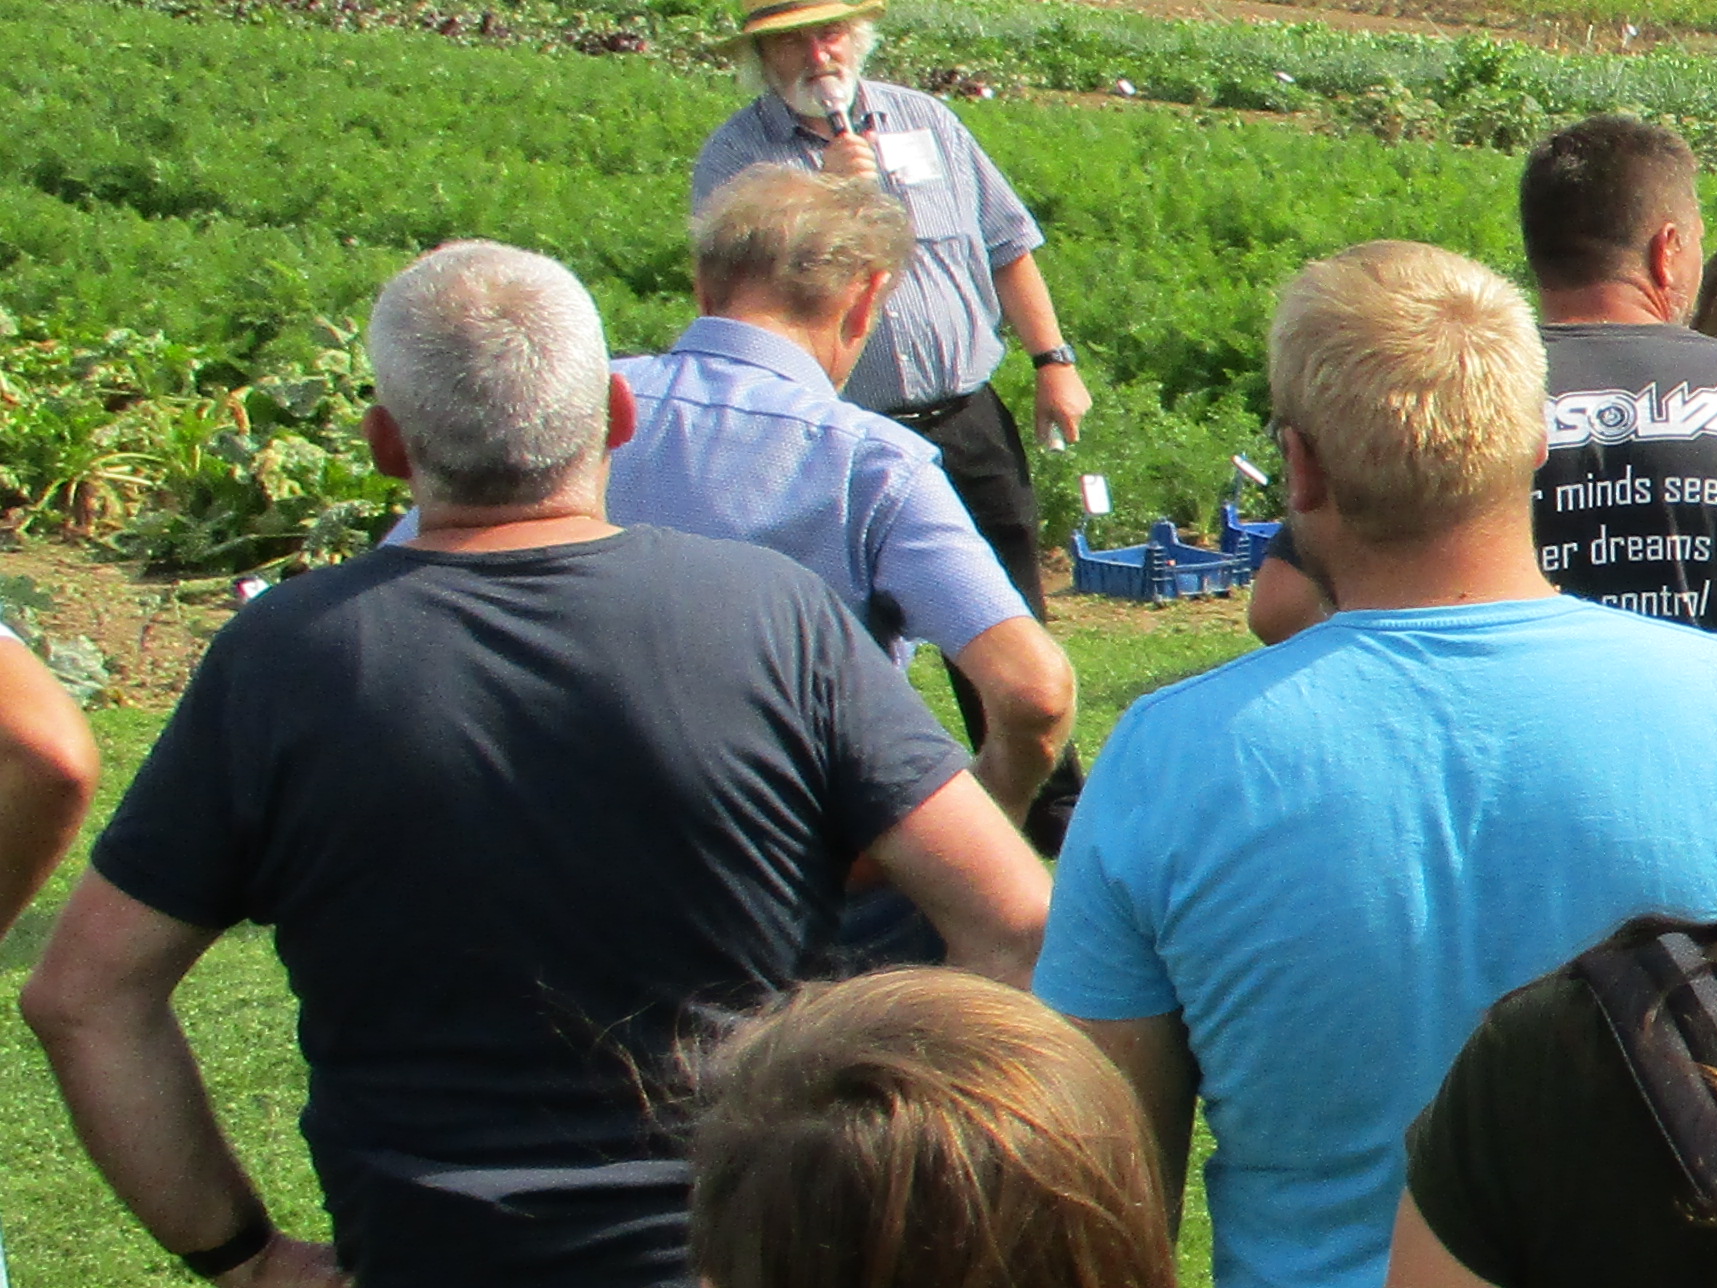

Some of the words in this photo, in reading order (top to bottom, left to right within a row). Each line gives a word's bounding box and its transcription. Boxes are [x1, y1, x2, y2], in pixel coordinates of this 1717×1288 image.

[1556, 465, 1651, 512] minds
[1541, 542, 1579, 572] er
[1590, 524, 1711, 566] dreams
